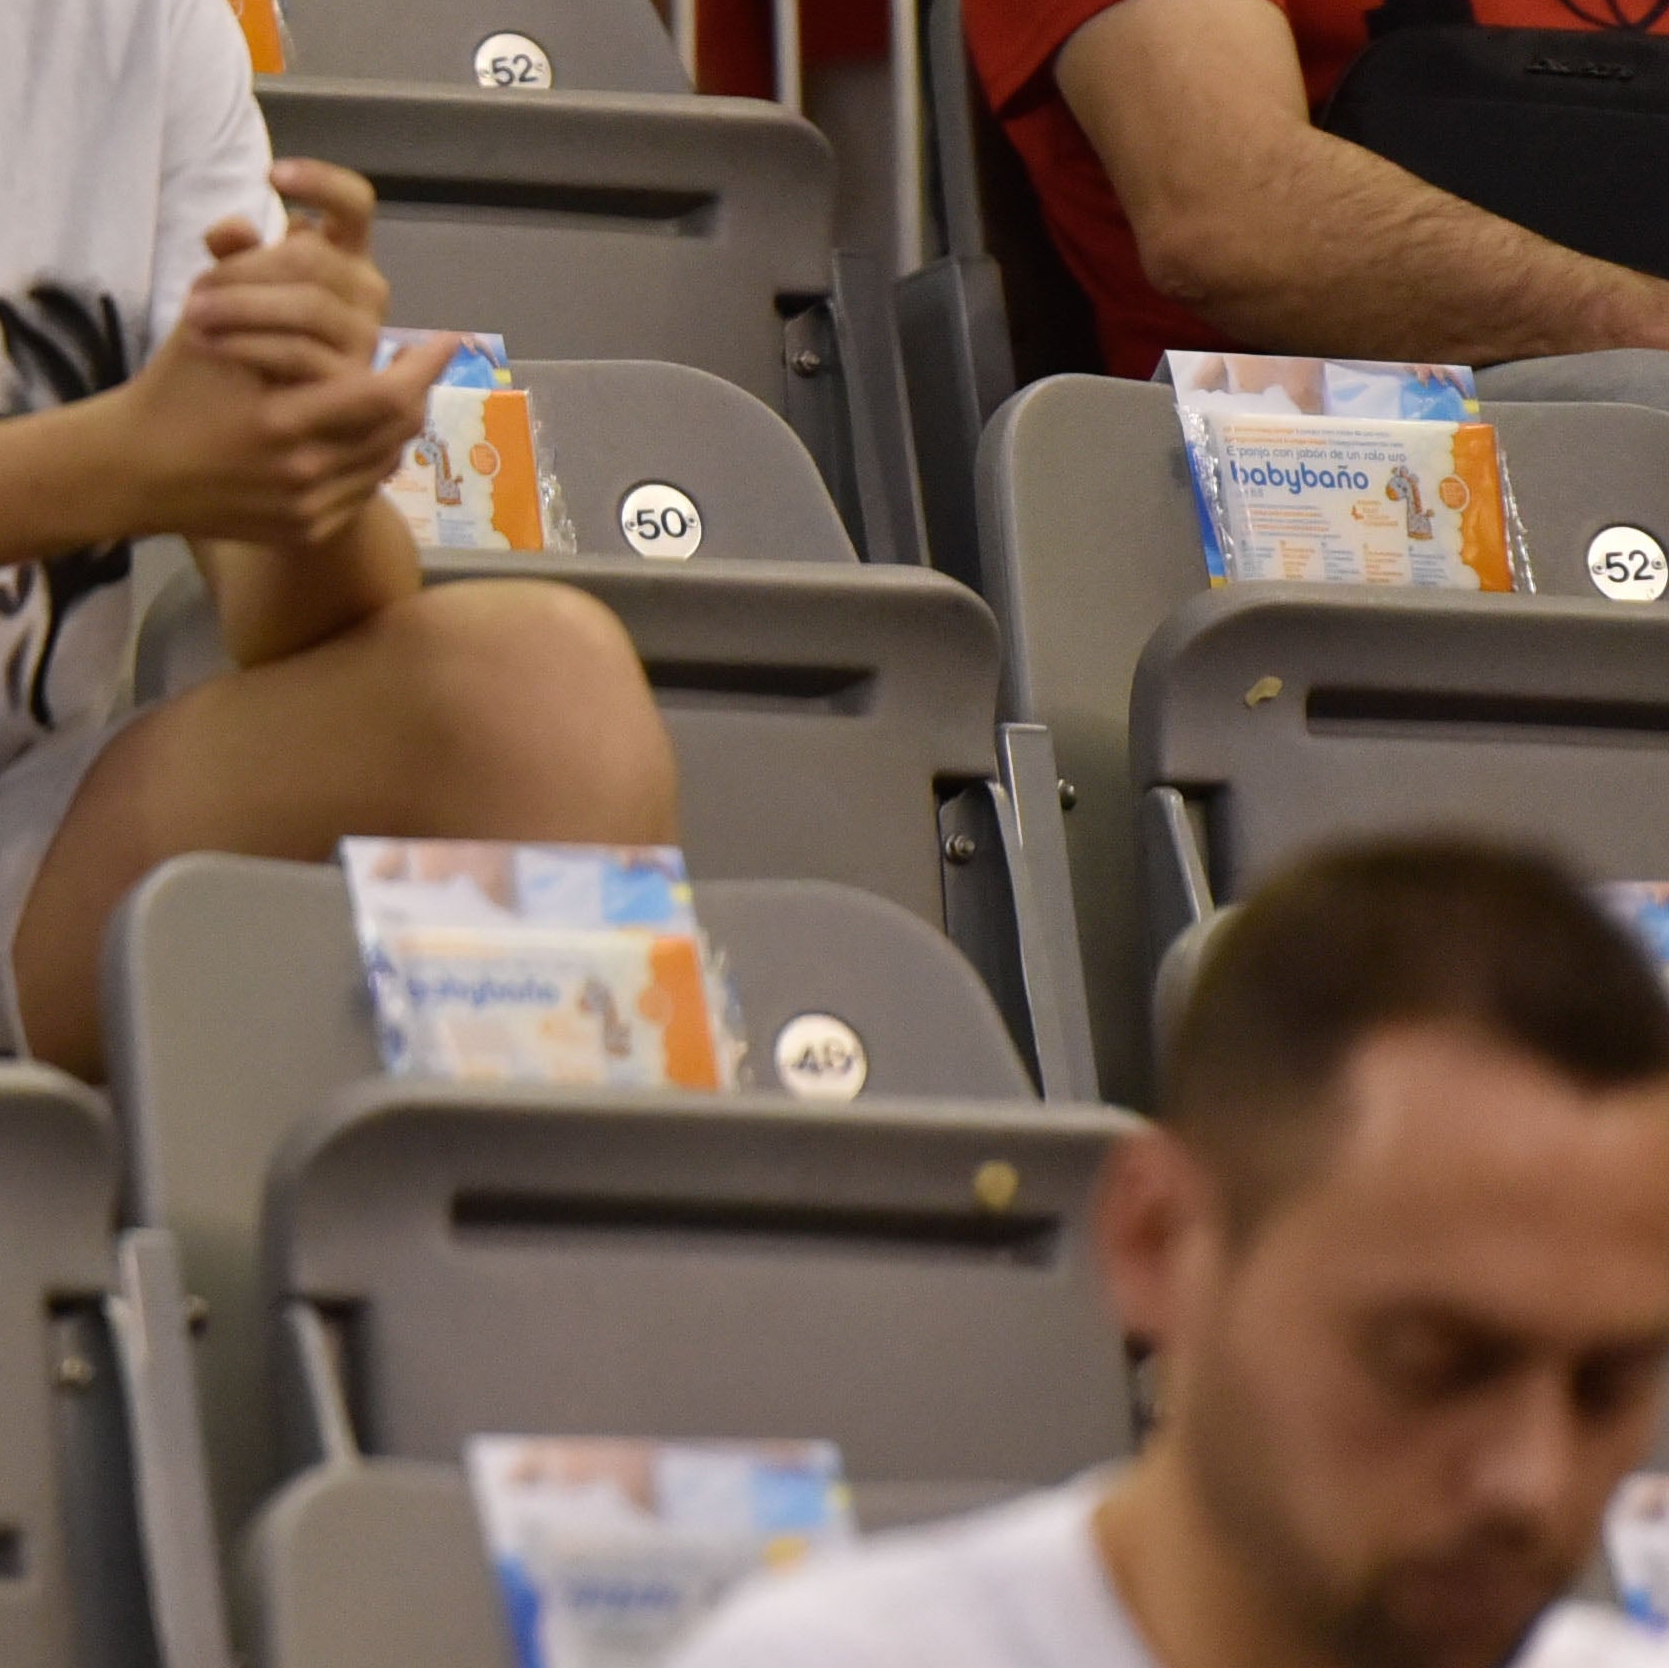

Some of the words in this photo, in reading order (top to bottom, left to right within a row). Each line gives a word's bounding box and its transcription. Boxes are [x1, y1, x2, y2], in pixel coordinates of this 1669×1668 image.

[492, 53, 538, 85] 52
[1272, 448, 1294, 458] con
[1296, 446, 1327, 460] jabón
[1330, 448, 1343, 460] de
[1346, 451, 1360, 460] un
[1229, 460, 1369, 495] babybaño
[636, 506, 688, 540] 50
[1605, 549, 1655, 583] 52
